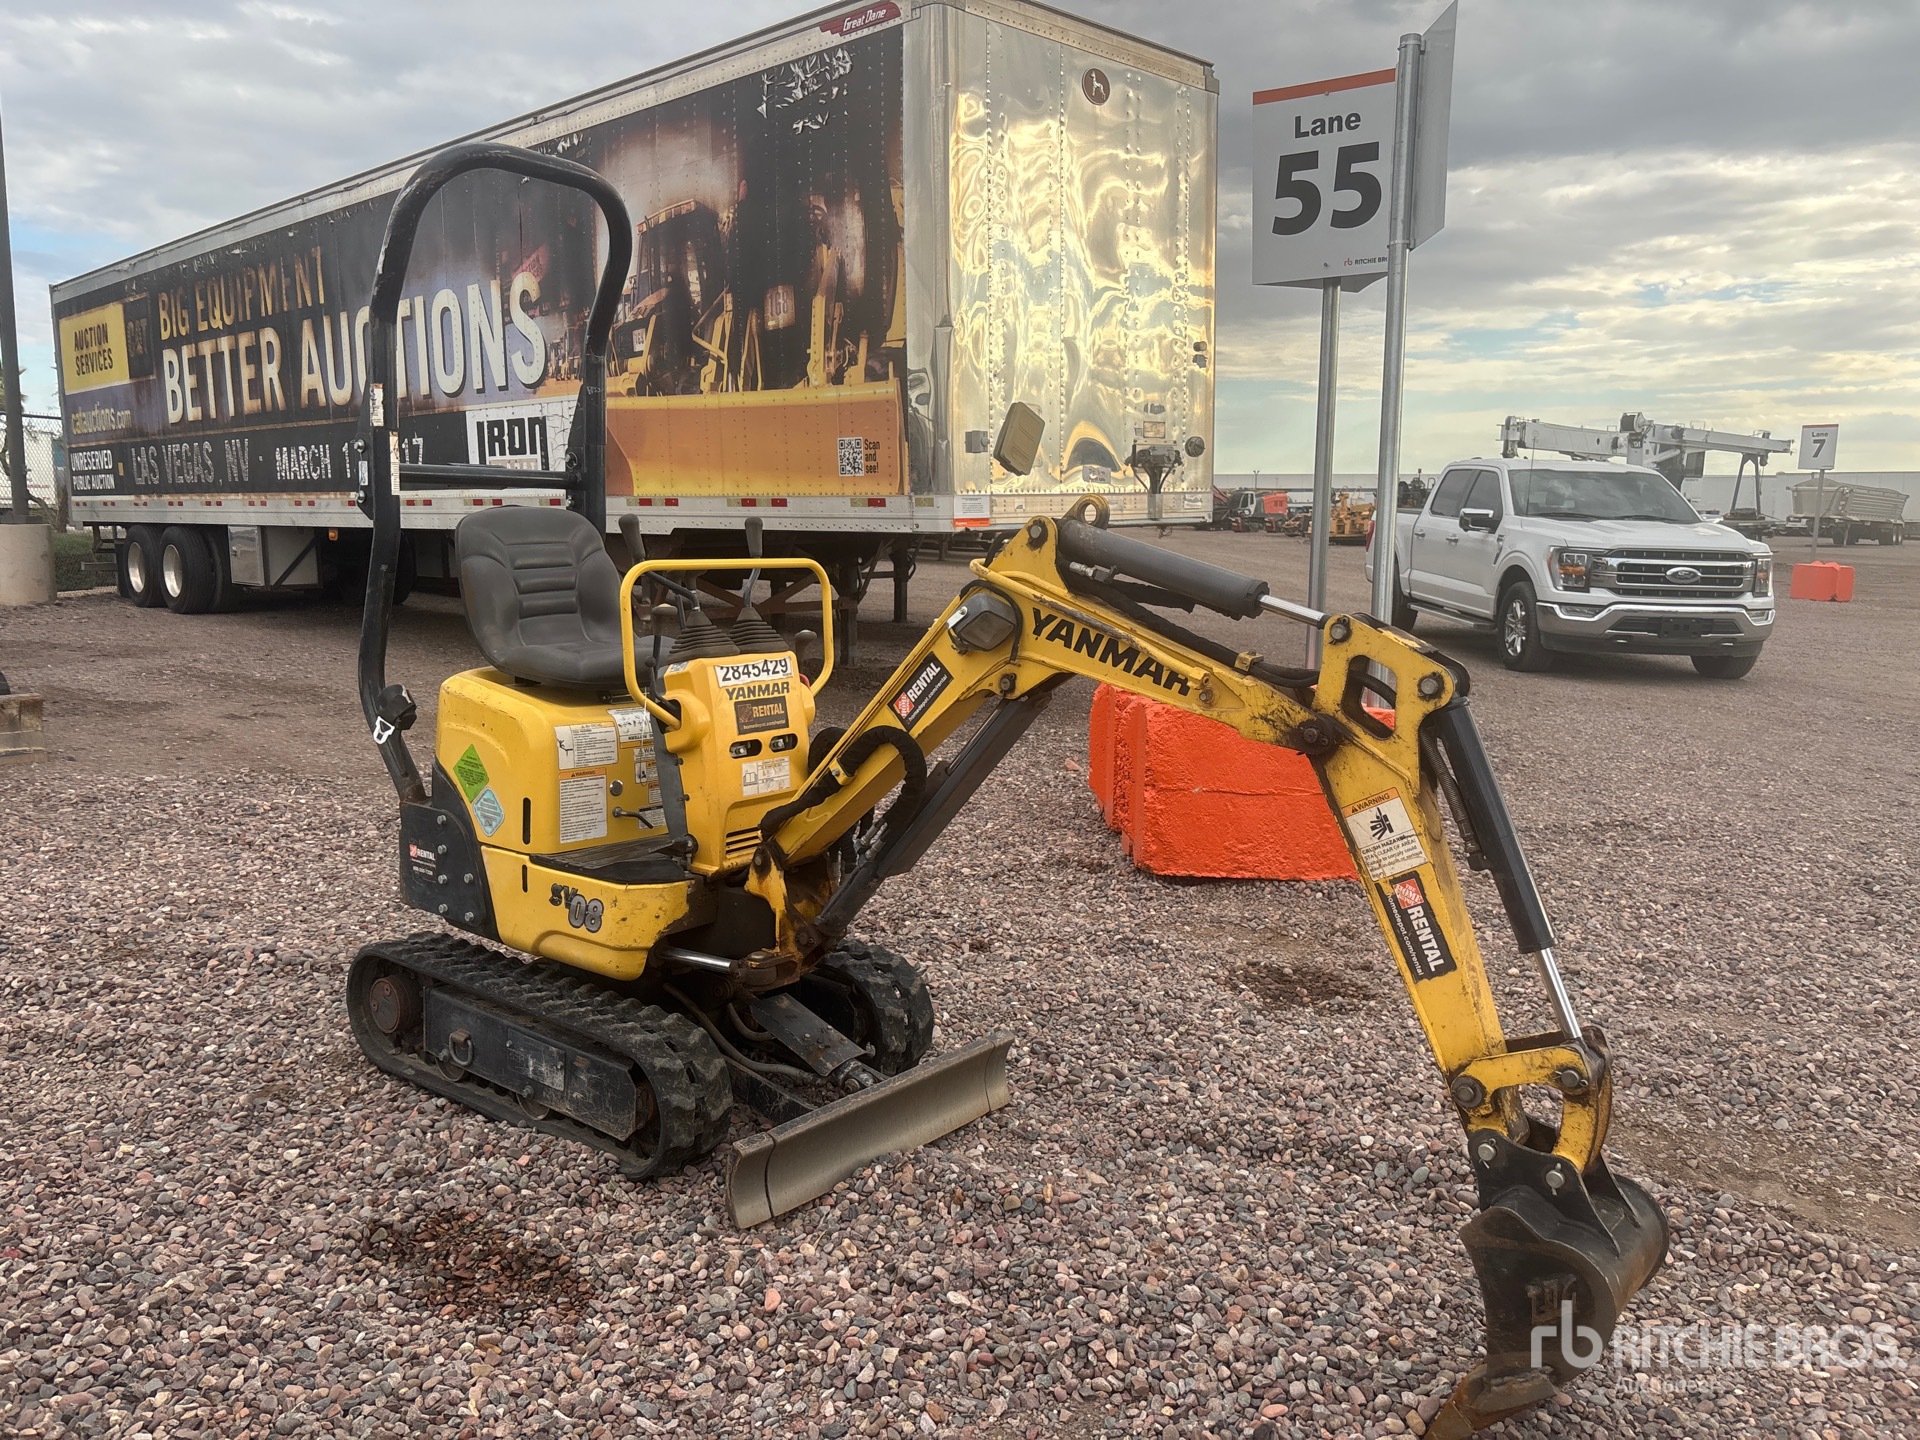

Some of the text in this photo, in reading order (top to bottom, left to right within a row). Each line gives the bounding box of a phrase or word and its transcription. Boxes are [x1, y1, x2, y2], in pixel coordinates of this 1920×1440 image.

[843, 10, 886, 31] Great Dane
[1294, 112, 1361, 138] Lane
[1271, 141, 1382, 236] 55
[1354, 257, 1377, 265] RITCHIE
[158, 246, 325, 341] BIG EQUIPMENT
[74, 323, 109, 352] AUCTION
[75, 348, 113, 376] SERVICES
[162, 327, 286, 424] BETTER
[864, 439, 880, 450] Scan
[1812, 439, 1826, 458] 7
[70, 450, 113, 471] UNRESERVED
[131, 446, 159, 485] LAS
[224, 439, 249, 482] NV
[276, 444, 331, 480] MARCH
[864, 451, 877, 462] and
[865, 462, 879, 473] see!
[72, 473, 116, 491] PUBLIC AUCTION
[1032, 606, 1192, 697] YANMAR
[719, 657, 789, 681] 2845429
[725, 681, 790, 701] YANMAR
[906, 662, 941, 703] RENTAL
[752, 703, 785, 718] RENTAL
[1357, 793, 1390, 811] WARNING
[1407, 905, 1444, 972] RENTAL
